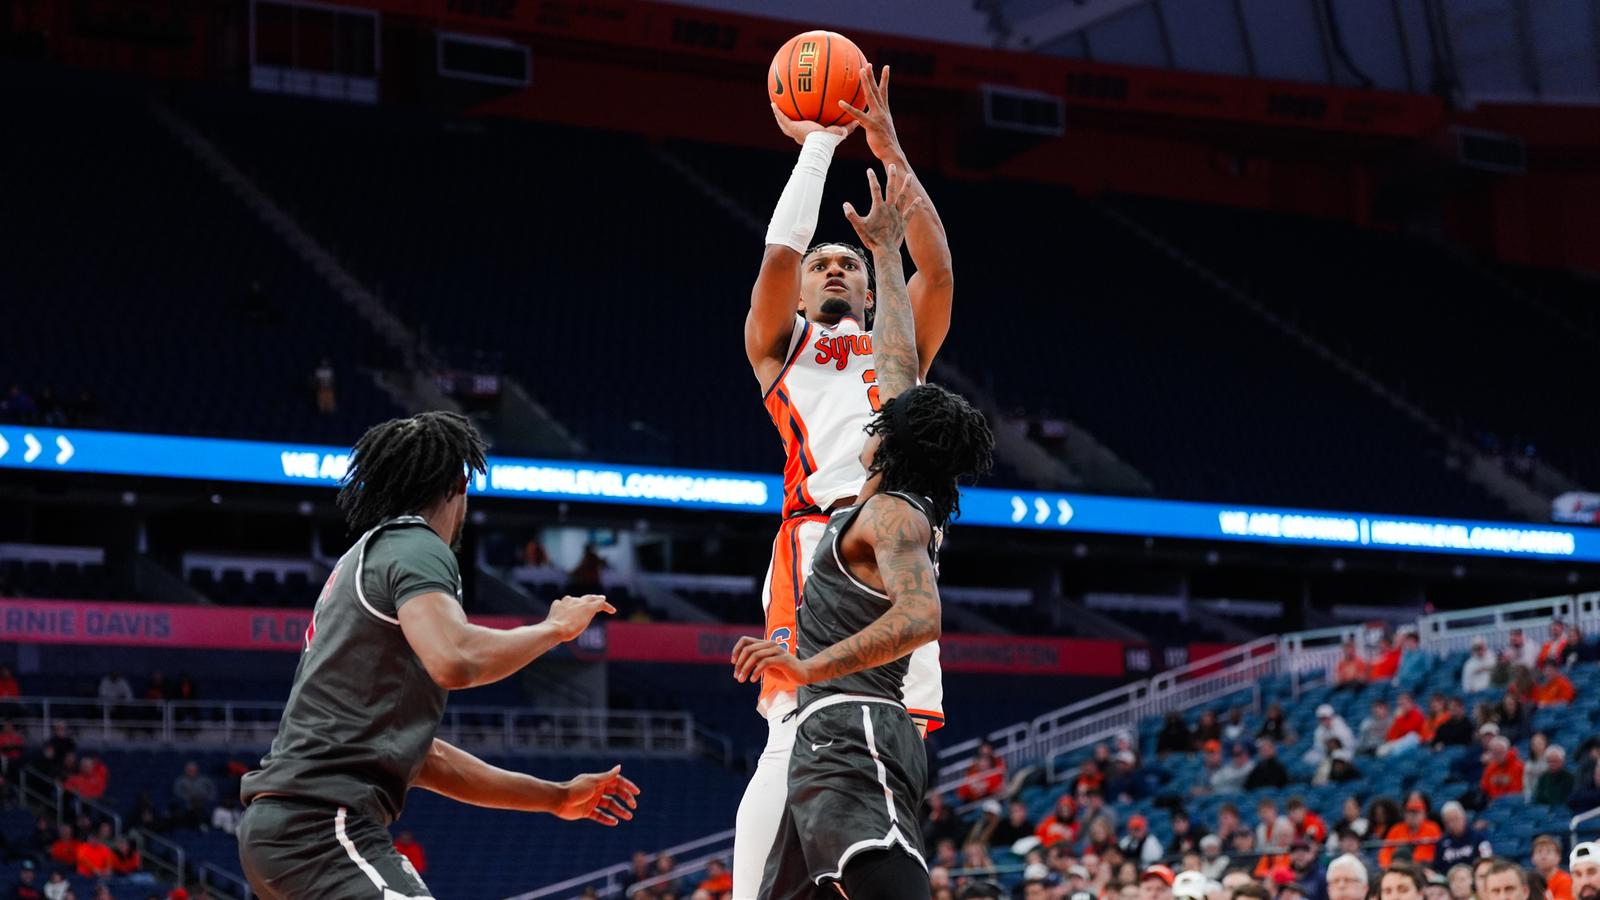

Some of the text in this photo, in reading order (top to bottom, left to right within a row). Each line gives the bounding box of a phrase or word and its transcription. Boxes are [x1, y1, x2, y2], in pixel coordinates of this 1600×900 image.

[814, 334, 873, 371] Syra
[281, 451, 352, 481] WE AR
[1219, 510, 1248, 536] WE
[0, 606, 172, 639] RNIE DAVIS
[251, 616, 309, 643] FLO
[936, 640, 1059, 667] SHINGTON
